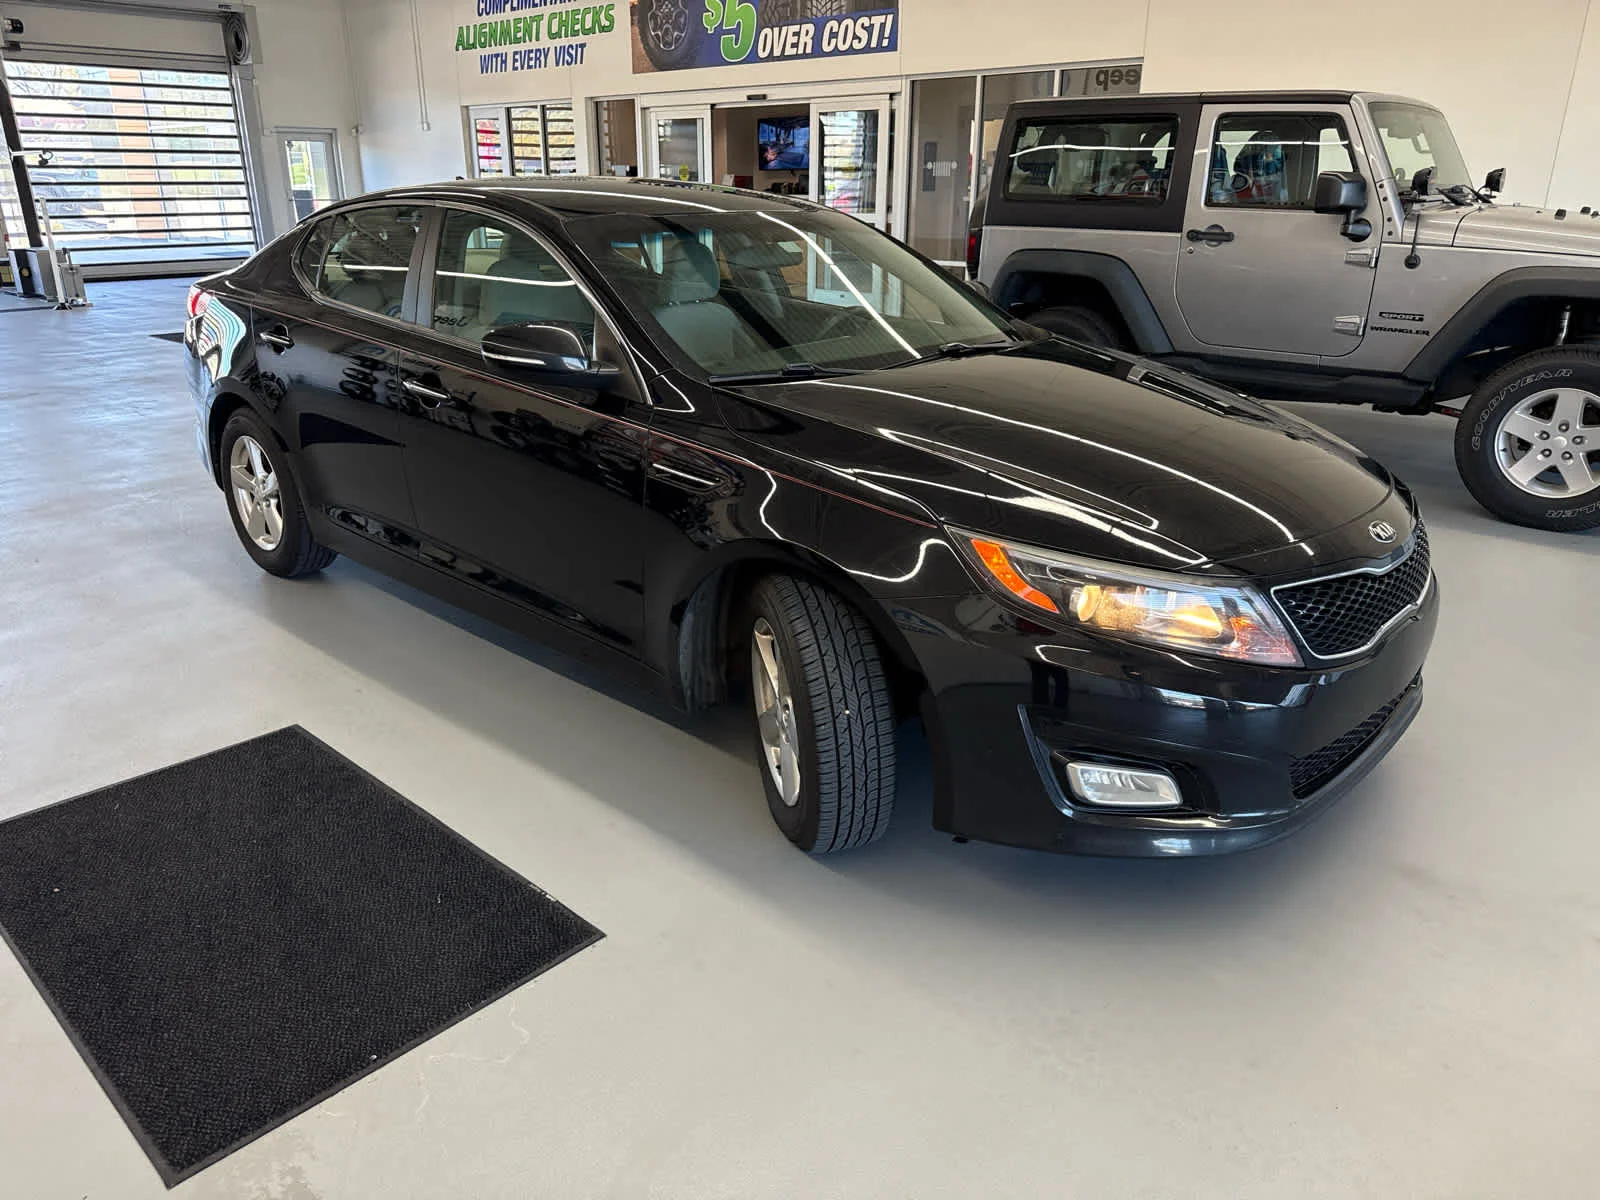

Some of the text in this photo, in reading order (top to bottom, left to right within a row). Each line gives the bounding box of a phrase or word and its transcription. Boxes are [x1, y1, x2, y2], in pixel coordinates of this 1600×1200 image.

[455, 4, 615, 51] ALIGNMENT CHECKS
[757, 23, 815, 59] OVER
[821, 14, 894, 53] COST!
[479, 43, 587, 74] WITH EVERY VISIT
[1370, 326, 1430, 336] WRANGLER
[1472, 368, 1573, 450] GOODYEAR
